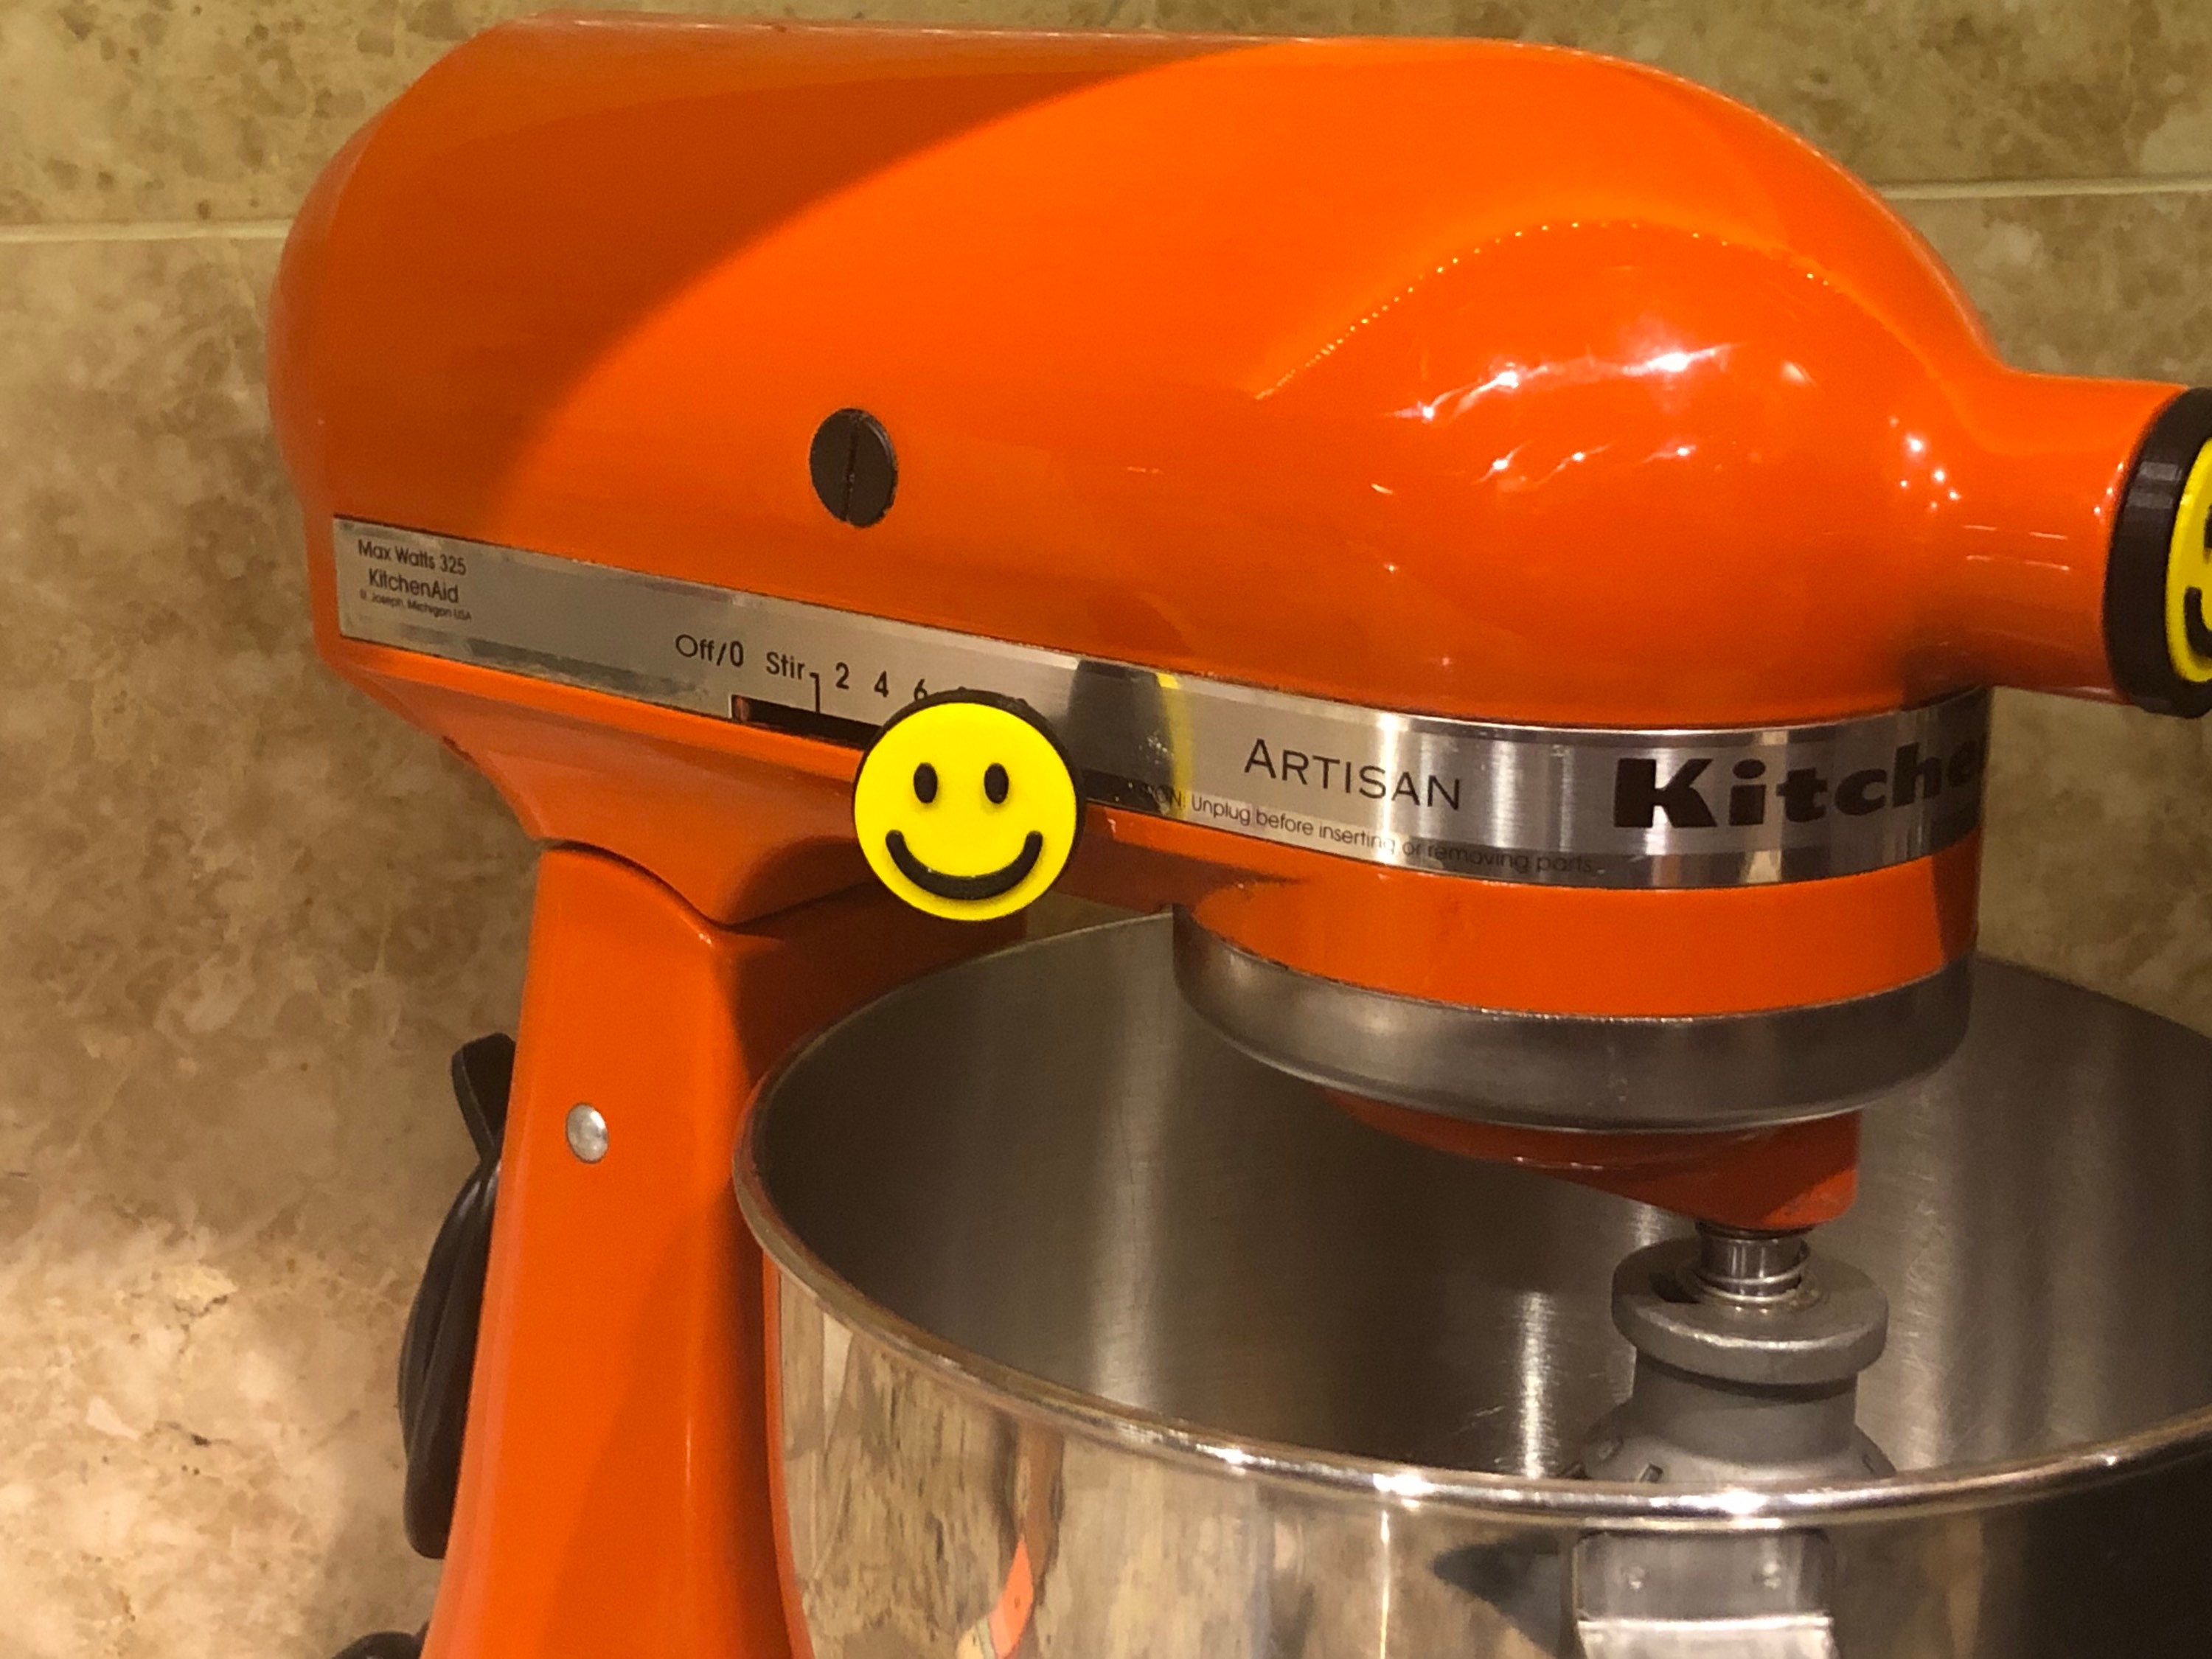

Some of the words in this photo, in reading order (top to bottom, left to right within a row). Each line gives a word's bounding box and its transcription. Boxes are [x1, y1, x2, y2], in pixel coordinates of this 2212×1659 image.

[358, 539, 392, 560] Max
[394, 546, 436, 568] Watts
[439, 554, 467, 576] 325
[369, 568, 459, 603] KitchenAid
[675, 634, 744, 667] Off/0
[766, 652, 805, 681] Stir
[835, 662, 849, 689] 2
[874, 671, 888, 698] 4
[914, 678, 928, 701] 6
[1244, 738, 1461, 810] ARTISAN
[1614, 740, 1982, 827] Kitche
[1191, 794, 1252, 827] Unplug
[1256, 809, 1314, 836] before
[1318, 824, 1396, 855] inserting
[1402, 841, 1420, 856] or
[1425, 841, 1529, 874] removing
